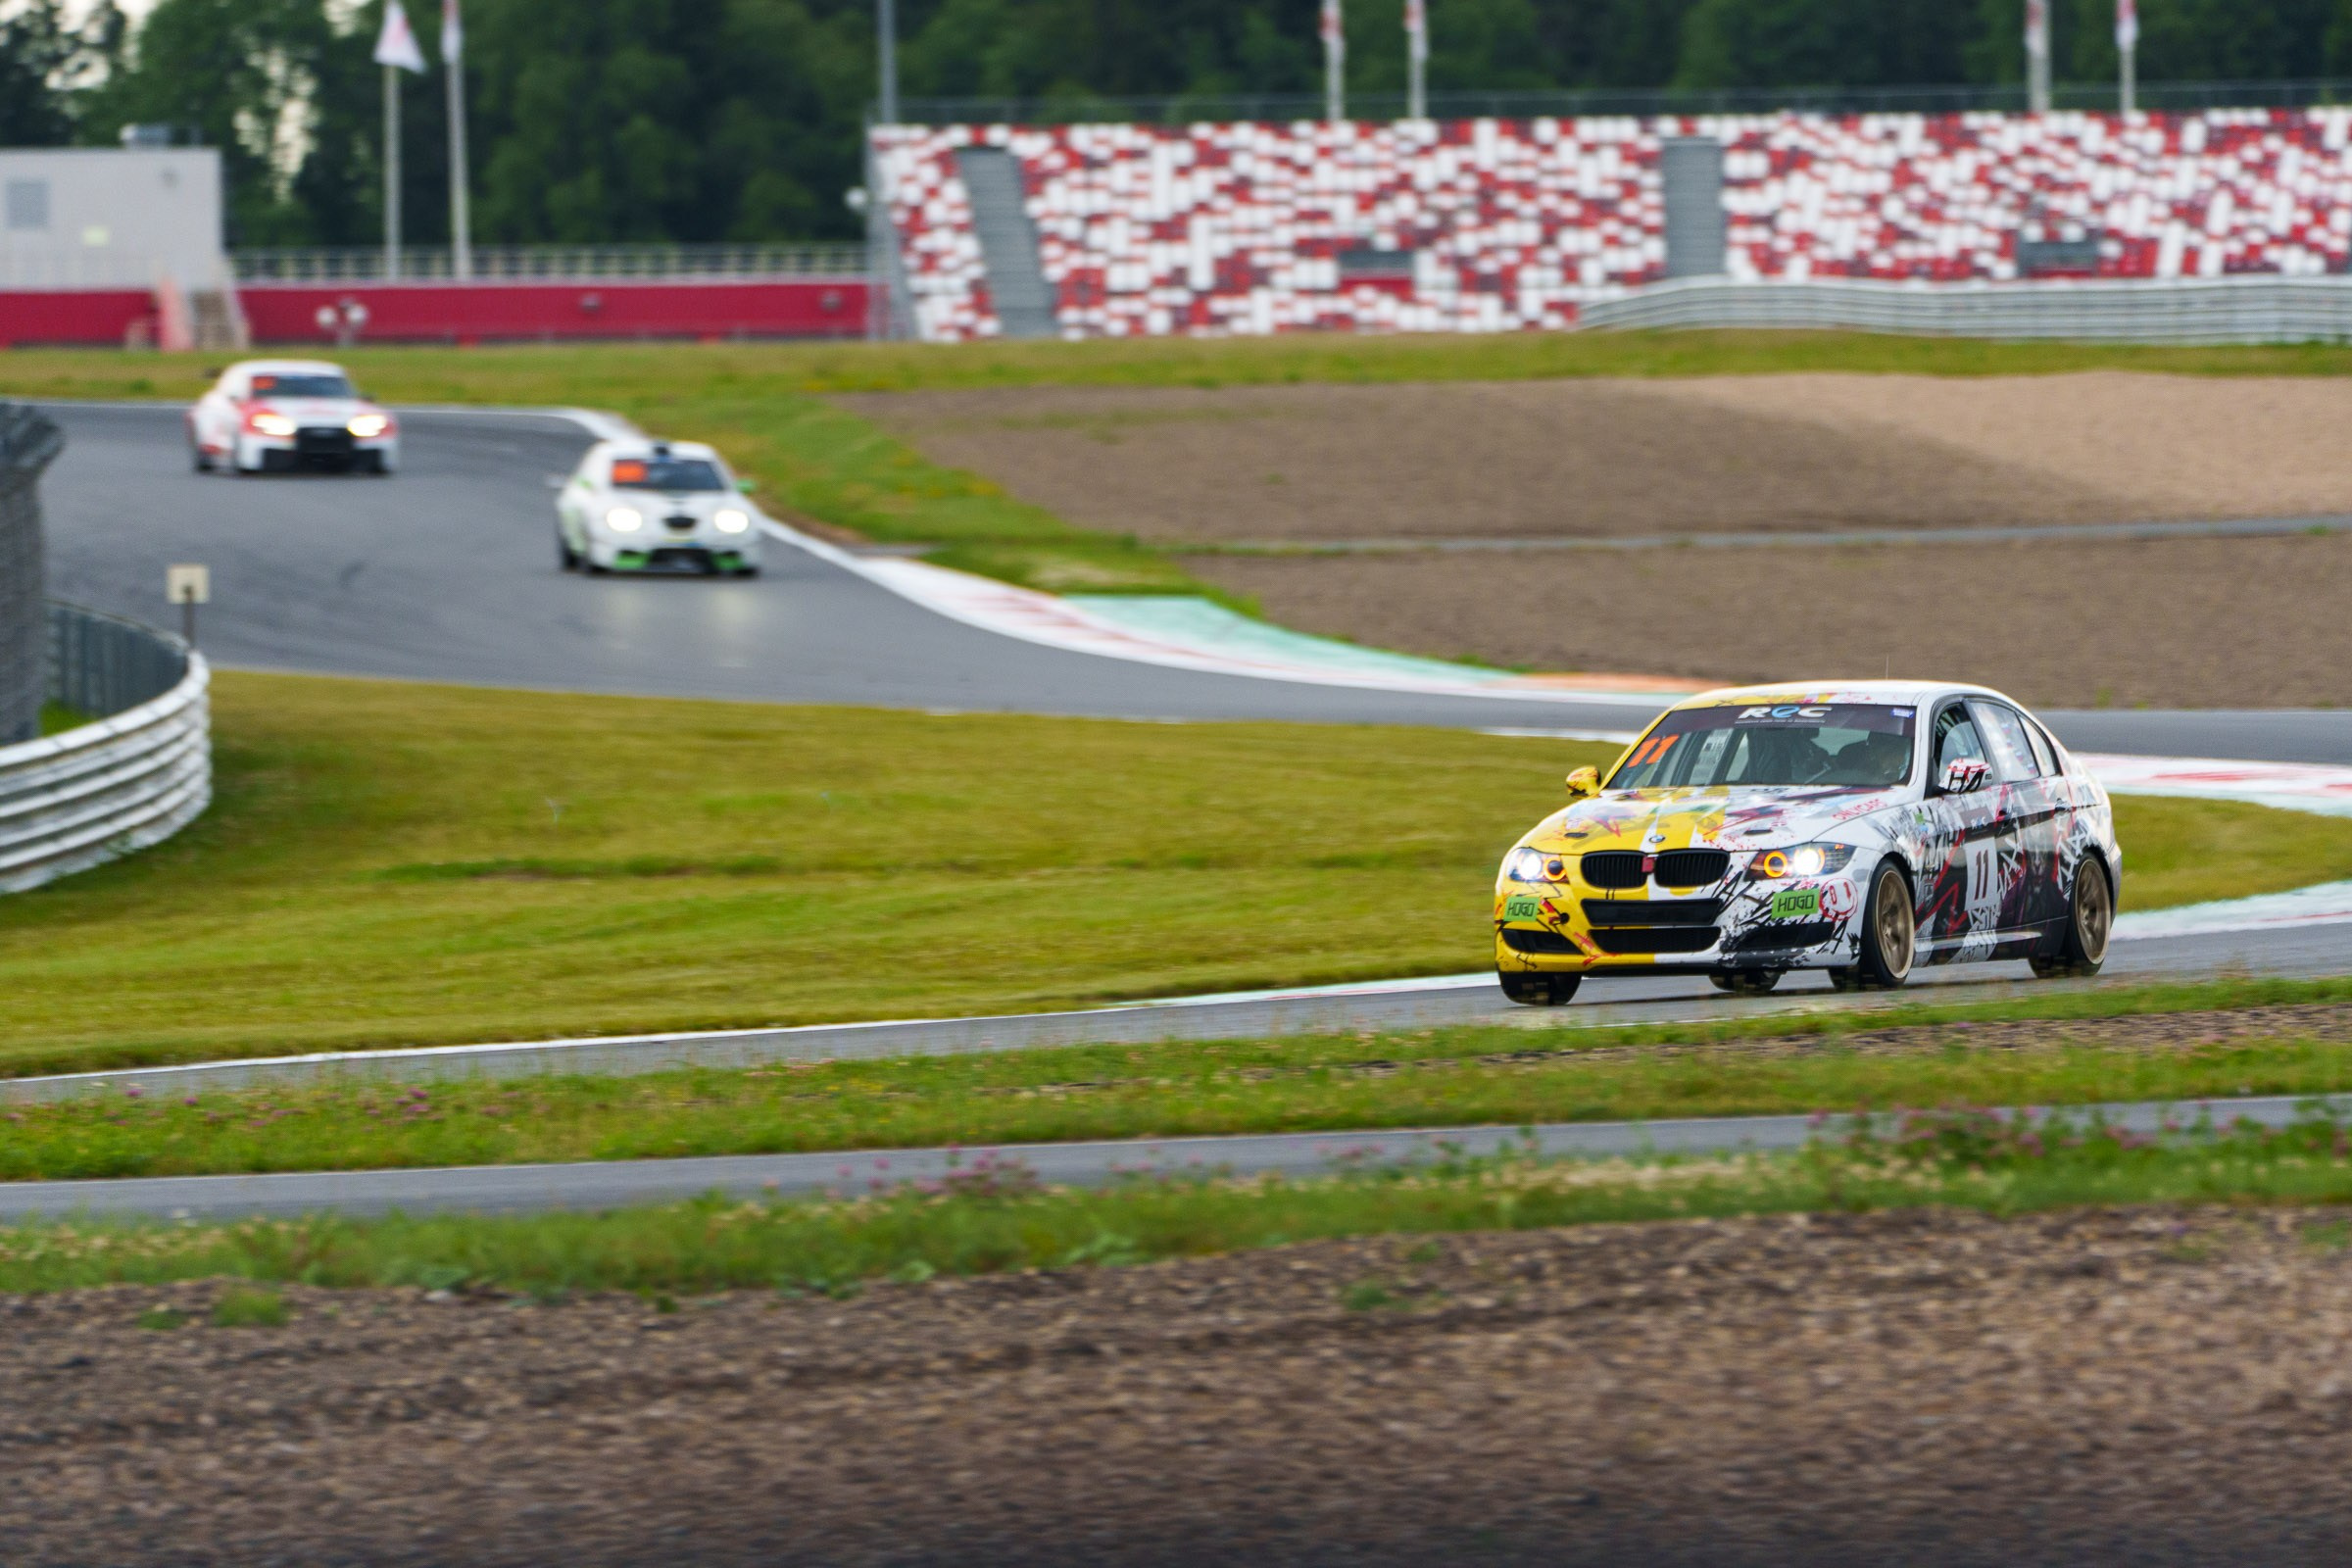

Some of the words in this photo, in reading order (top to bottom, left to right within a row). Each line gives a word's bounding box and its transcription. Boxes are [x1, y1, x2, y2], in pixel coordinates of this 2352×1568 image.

[1627, 734, 1680, 768] 11
[1975, 849, 1988, 901] 11
[1508, 902, 1535, 916] HOGO
[1778, 894, 1815, 912] HOGO
